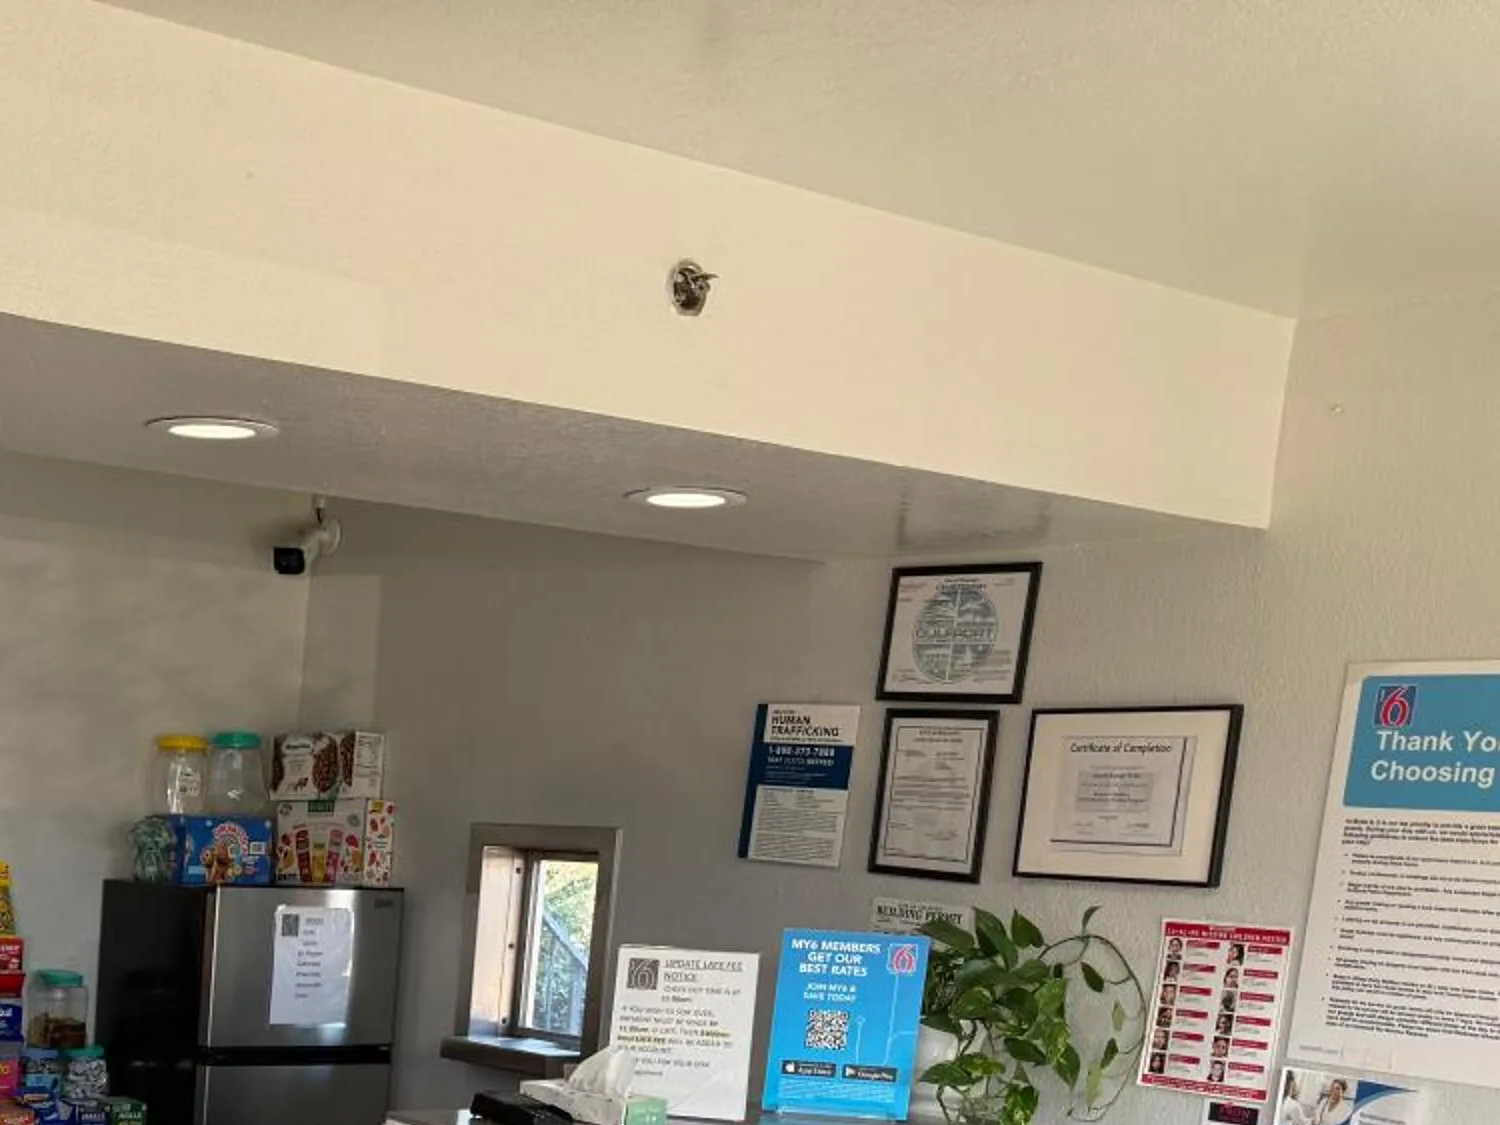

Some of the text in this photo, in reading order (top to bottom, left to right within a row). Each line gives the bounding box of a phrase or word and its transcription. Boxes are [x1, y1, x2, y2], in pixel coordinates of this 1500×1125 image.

[771, 715, 811, 725] HUMAN
[771, 725, 840, 737] TRAFFICKING
[1377, 730, 1500, 753] Thank Yo
[1371, 760, 1496, 789] Choosing
[792, 939, 881, 954] MY6 MEMBERS
[808, 952, 862, 965] GET OUR
[799, 963, 868, 977] BEST RATES
